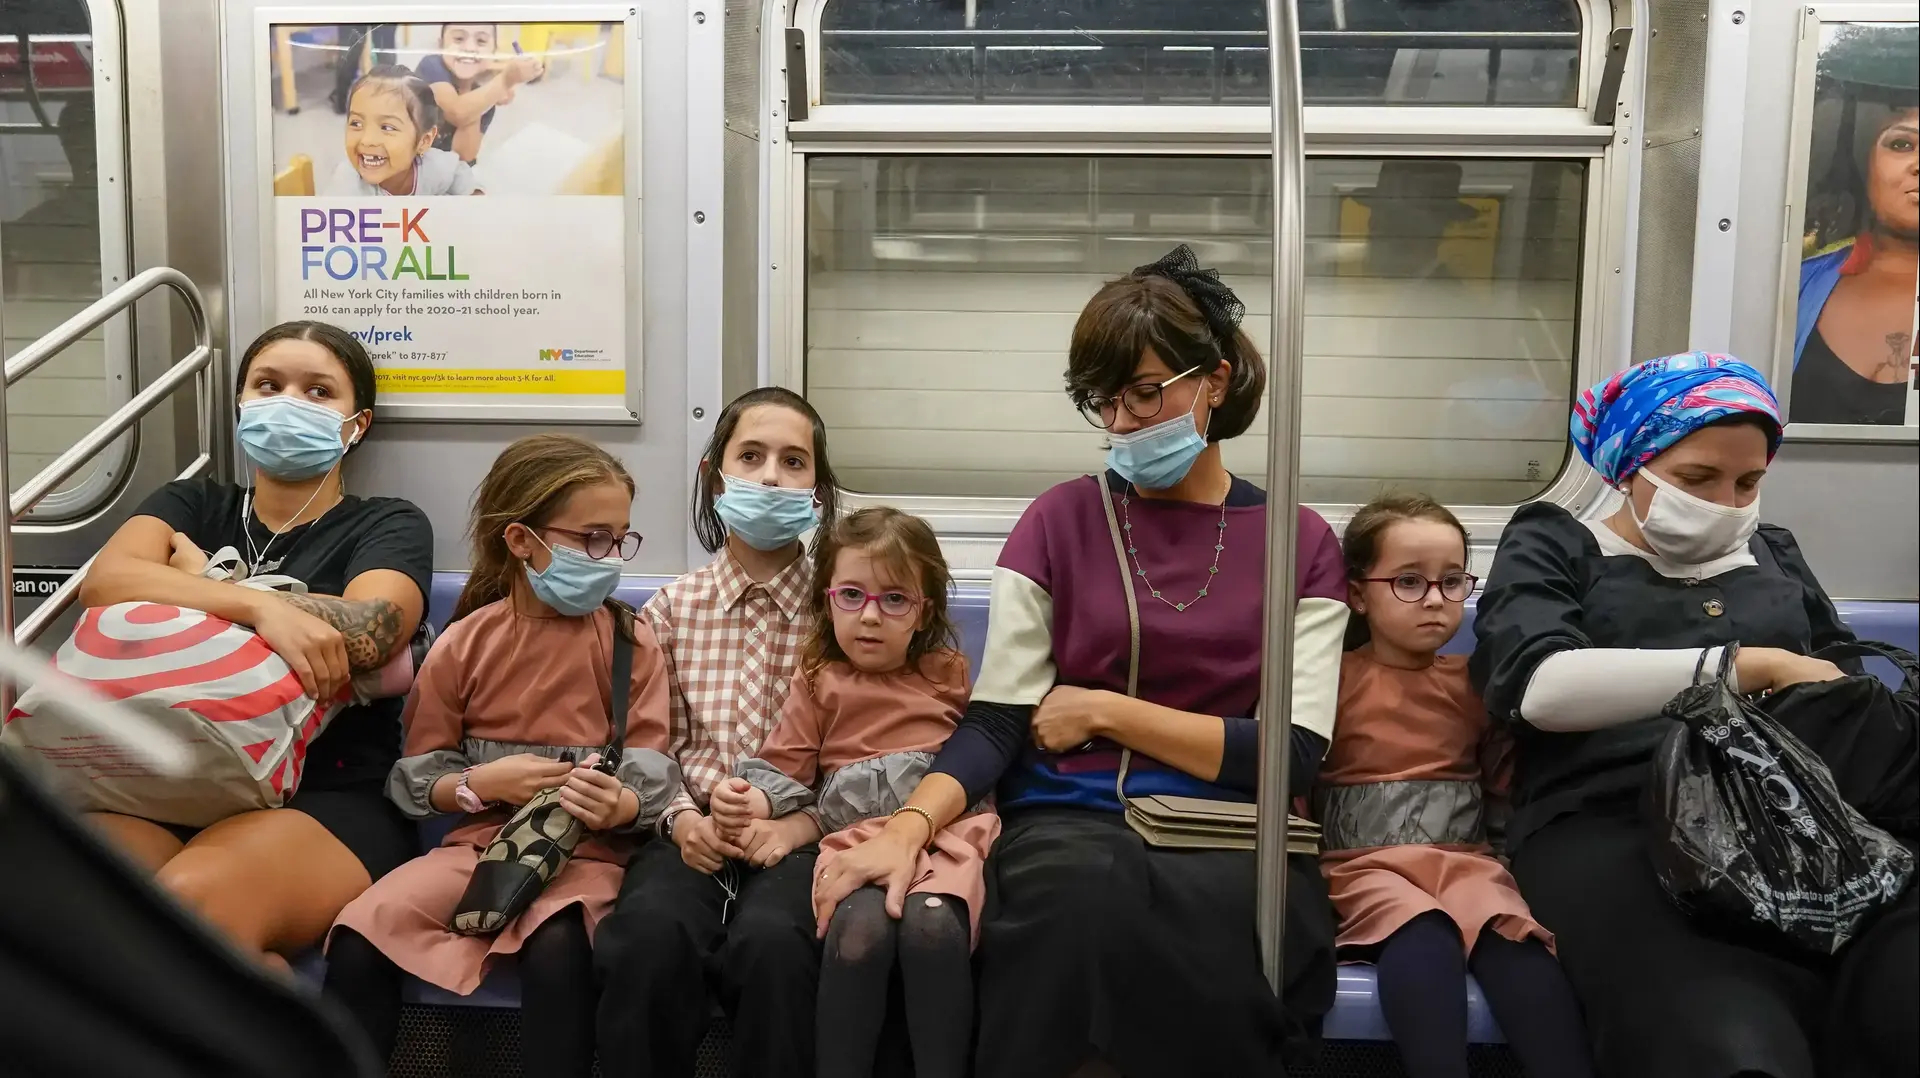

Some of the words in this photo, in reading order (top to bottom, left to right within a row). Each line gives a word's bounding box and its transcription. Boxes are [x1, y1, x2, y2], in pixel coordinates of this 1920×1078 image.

[301, 208, 430, 243] PRE-K
[302, 245, 389, 281] FOR
[391, 245, 470, 281] ALL
[303, 288, 318, 299] All
[321, 288, 345, 299] New
[348, 288, 373, 299] York
[376, 288, 399, 302] City
[402, 288, 445, 300] families
[447, 289, 471, 300] with
[474, 289, 519, 300] children
[522, 289, 548, 300] born
[551, 289, 562, 300] in
[303, 305, 329, 314] 2016
[332, 306, 351, 314] can
[354, 303, 383, 317] apply
[386, 303, 402, 315] for
[405, 303, 424, 315] the
[475, 304, 511, 315] school
[513, 306, 540, 317] year.
[349, 325, 413, 346] ov/prek
[399, 352, 409, 360] to
[411, 352, 447, 361] 877-877
[539, 349, 574, 361] NYC
[408, 374, 446, 382] nyc.gov/3k
[517, 374, 530, 382] 3-K
[13, 580, 36, 593] an
[38, 580, 60, 593] on
